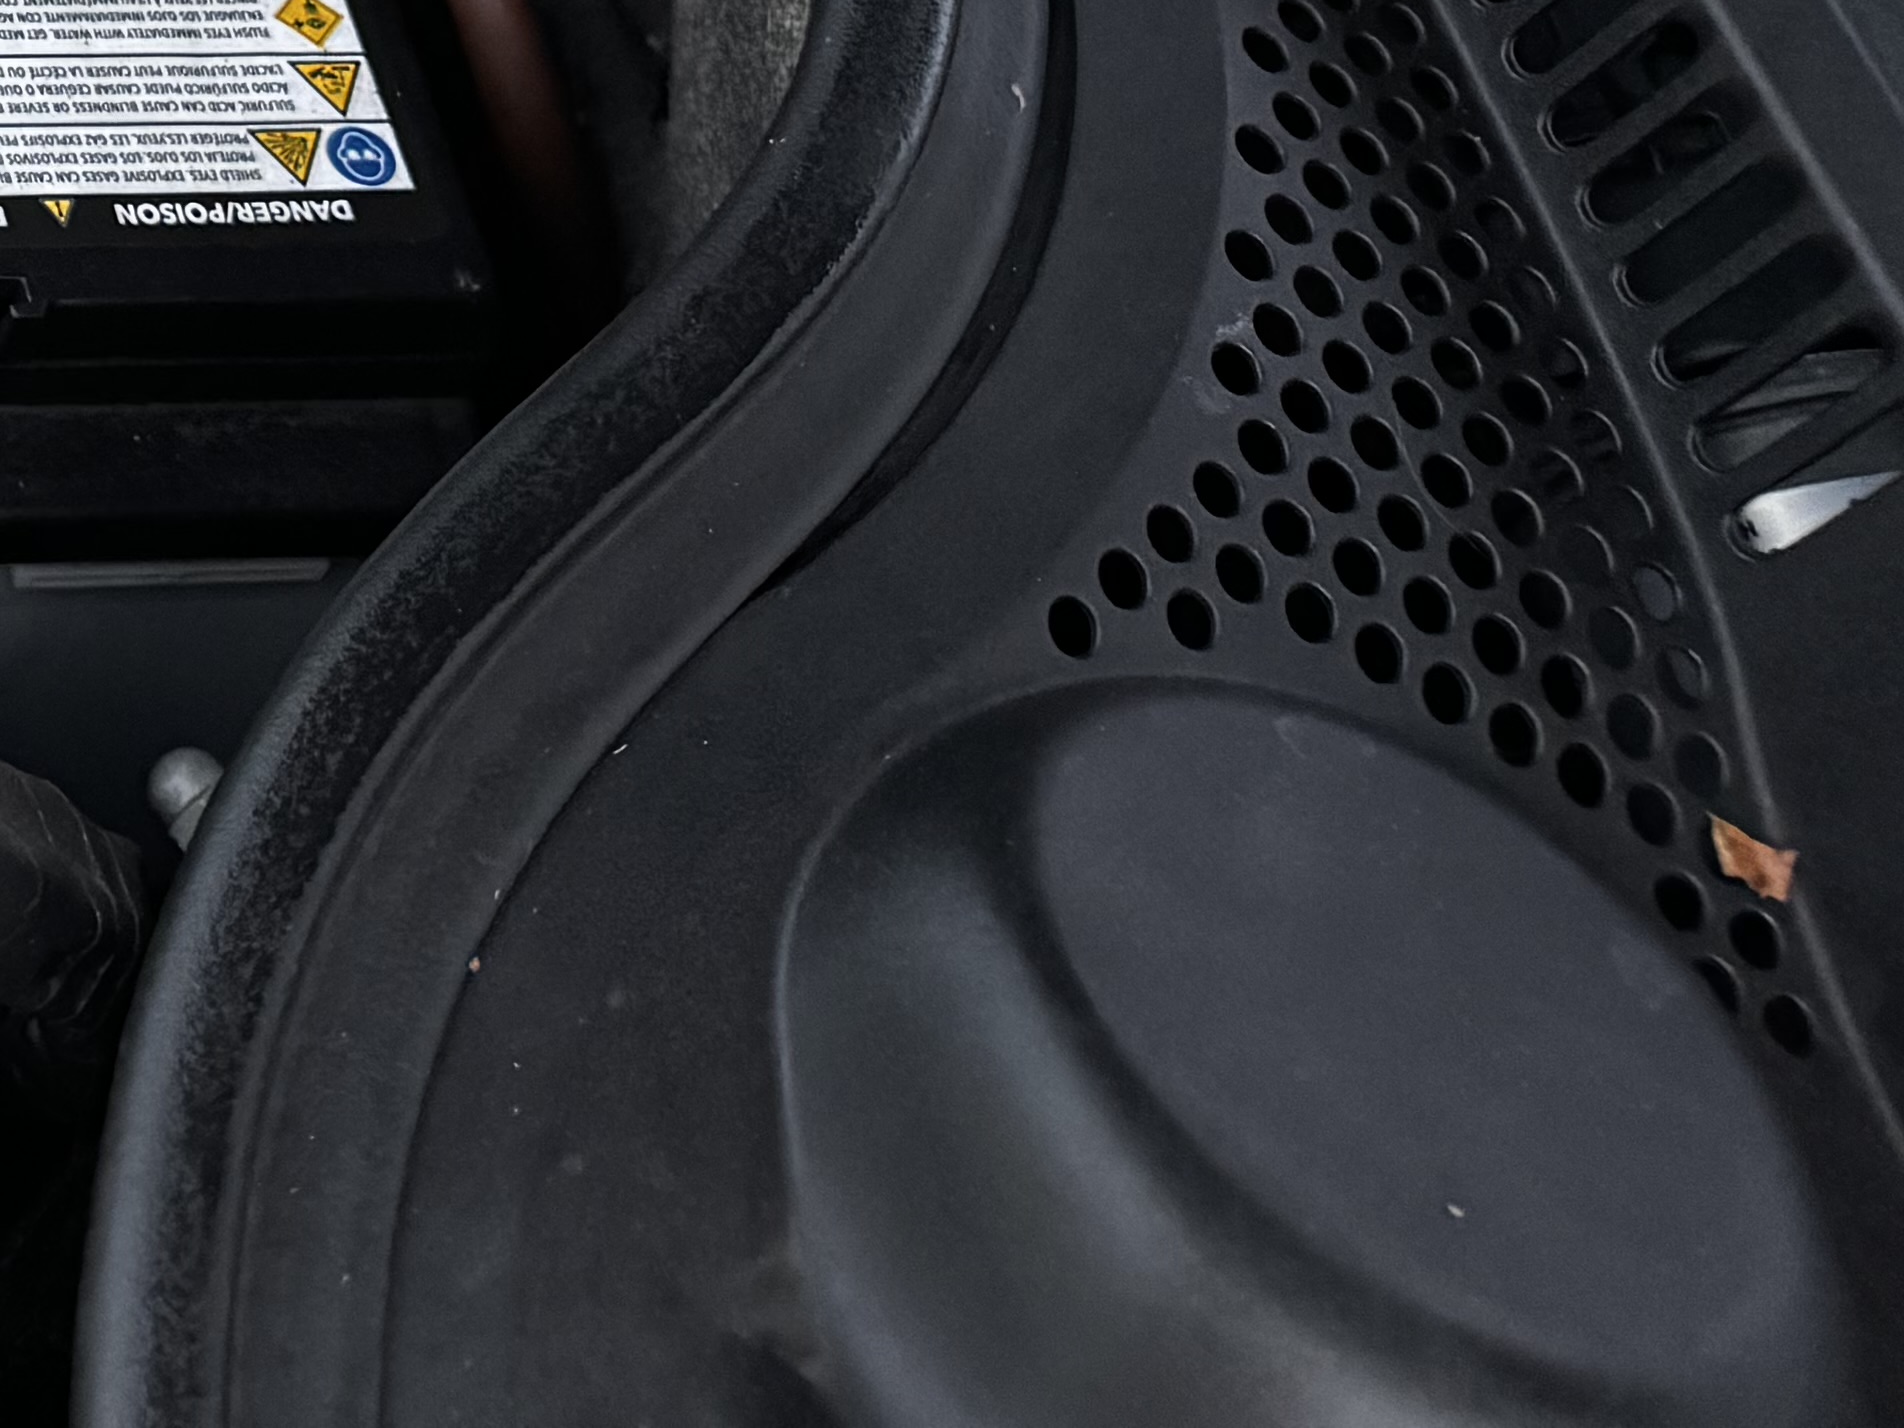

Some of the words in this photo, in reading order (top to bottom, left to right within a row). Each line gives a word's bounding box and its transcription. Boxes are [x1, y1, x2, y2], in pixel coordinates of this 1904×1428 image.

[25, 28, 48, 40] GET
[92, 28, 125, 39] WITH
[125, 27, 202, 38] IMMEDIATELY
[202, 26, 231, 37] EYES
[231, 26, 270, 37] FLUSH
[6, 66, 25, 78] OU
[67, 66, 84, 77] LA
[84, 65, 132, 77] CAUSER
[132, 65, 163, 76] PEUT
[164, 64, 238, 76] SULFURIQUE
[24, 84, 35, 95] O
[93, 83, 141, 94] CAUSAR
[141, 82, 182, 94] PUEDE
[6, 102, 51, 114] SEVERE
[51, 102, 71, 113] OR
[71, 101, 139, 113] BLINDNESS
[139, 100, 179, 112] CAUSE
[180, 100, 206, 111] CAN
[206, 99, 237, 111] ACID
[237, 99, 296, 110] SULFURIC
[19, 134, 83, 147] EXPLOSIFS
[83, 134, 108, 146] GAZ
[109, 134, 130, 146] LES
[166, 133, 189, 145] LES
[188, 132, 250, 147] PROTÉGER
[4, 152, 78, 165] EXPLOSIVOS
[79, 151, 118, 164] GASES
[118, 151, 143, 163] LOS
[141, 151, 179, 163] OJOS.
[179, 150, 203, 162] LOS
[203, 149, 256, 162] PROTEJA
[13, 171, 53, 183] CAUSE
[54, 171, 81, 182] CAN
[81, 170, 120, 182] GASES
[120, 169, 185, 181] EXPLOSIVE
[185, 168, 218, 180] EYES.
[218, 168, 262, 180] SHIELD
[113, 200, 355, 226] DANGER/POISON
